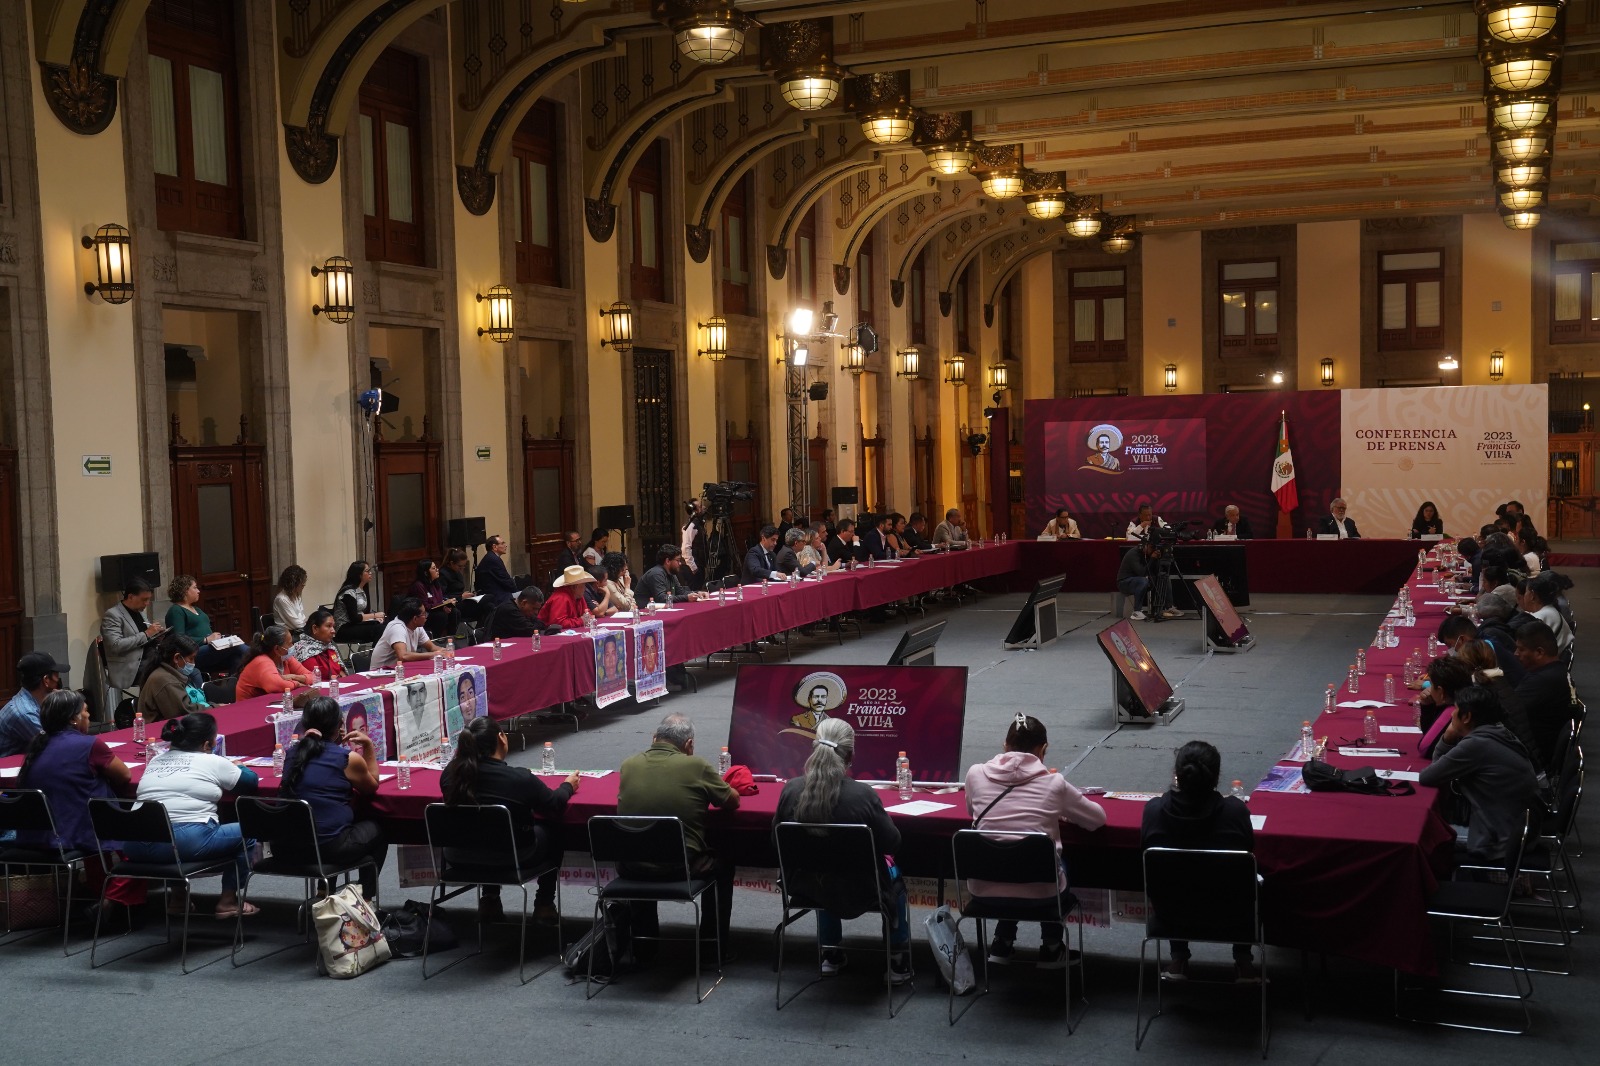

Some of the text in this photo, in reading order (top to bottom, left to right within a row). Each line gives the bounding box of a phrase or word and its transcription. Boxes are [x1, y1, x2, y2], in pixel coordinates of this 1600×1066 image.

[1131, 434, 1159, 443] 2023
[1355, 429, 1457, 439] CONFERENCIA
[1483, 431, 1513, 441] 2023
[1125, 444, 1167, 454] Francisco
[1367, 441, 1447, 451] DE PRENSA
[1476, 440, 1520, 451] Francisco
[858, 688, 897, 700] 2023
[847, 702, 906, 715] Francisco
